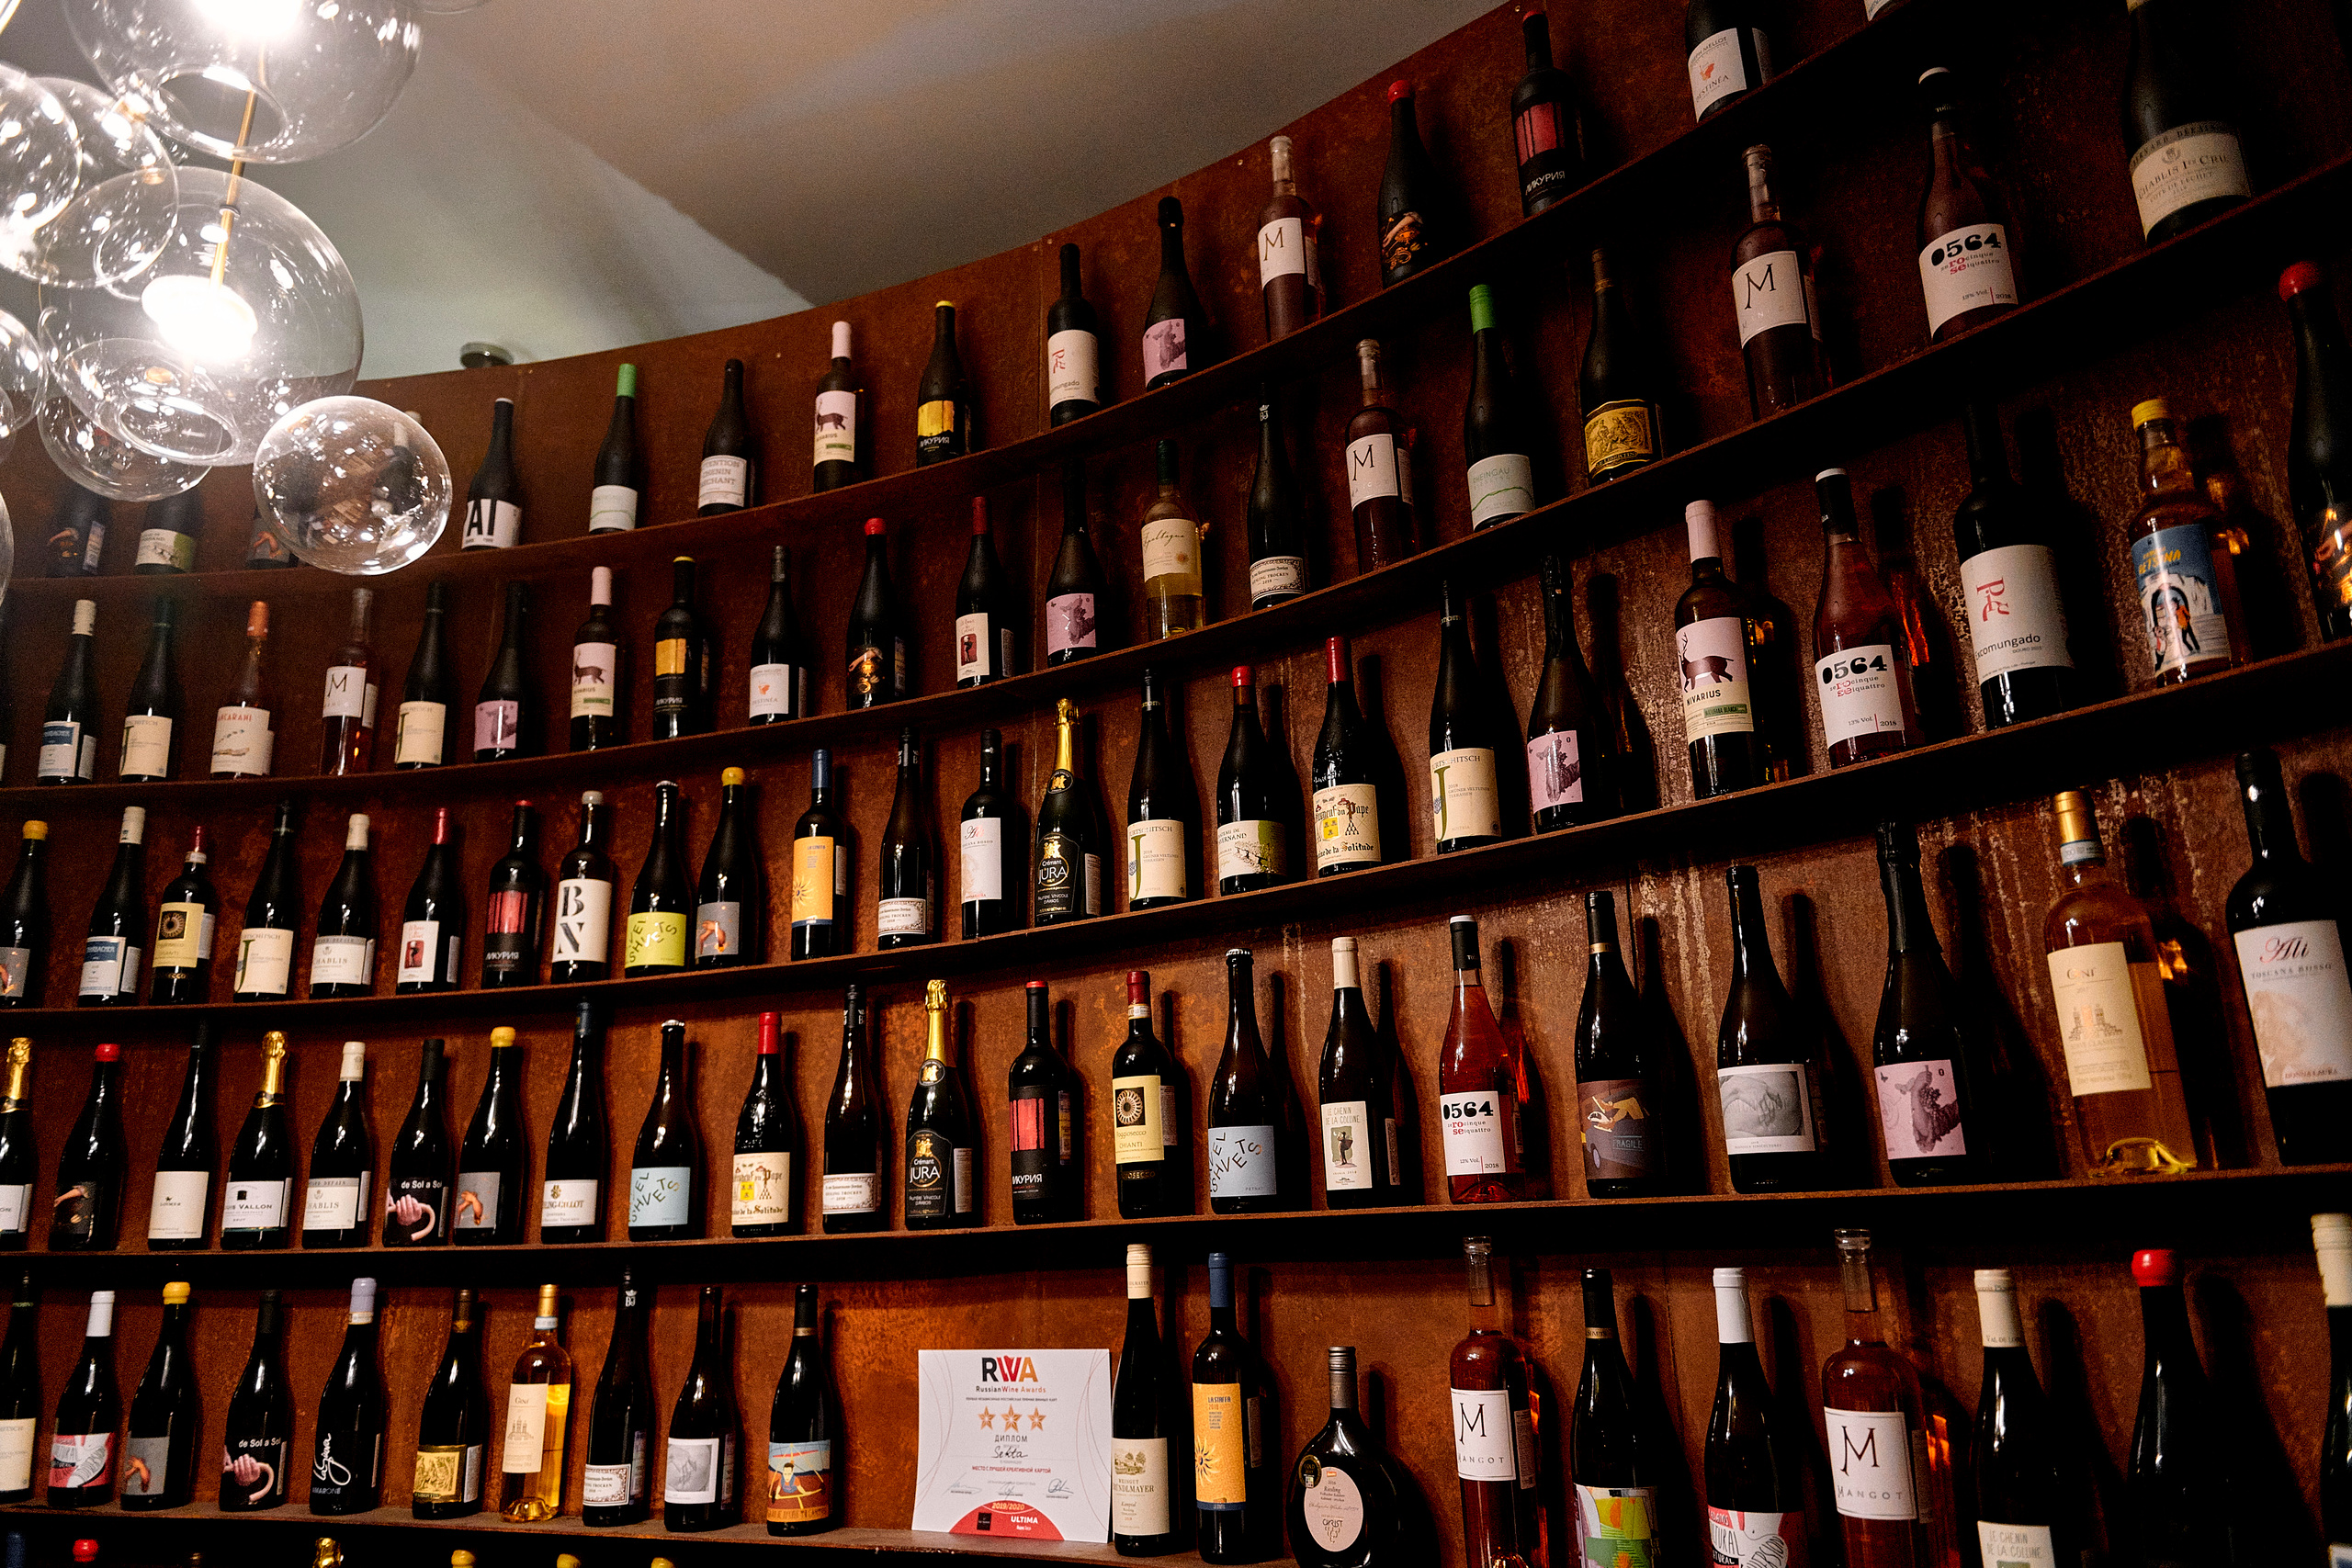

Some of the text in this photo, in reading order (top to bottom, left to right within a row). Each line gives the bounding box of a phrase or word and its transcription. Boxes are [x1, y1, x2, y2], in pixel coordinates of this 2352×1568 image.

[1263, 226, 1284, 262] M
[1931, 232, 2002, 266] 0564
[1744, 263, 1777, 310] M
[1352, 444, 1374, 481] M
[1822, 654, 1887, 684] 0564
[326, 673, 347, 697] M
[1686, 689, 1721, 706] NIVARIUS
[1346, 800, 1369, 818] Pape
[1340, 840, 1374, 852] Solitude
[1042, 859, 1062, 867] Crémant
[1038, 866, 1068, 885] JURA
[562, 886, 585, 917] B
[557, 922, 585, 955] N
[2259, 936, 2309, 964] Ali
[315, 956, 347, 965] HABLIS
[2251, 967, 2293, 979] TOSCANA
[1334, 1107, 1351, 1115] CHENIN
[1340, 1114, 1361, 1124] COLLINE
[1442, 1100, 1494, 1121] 0564
[1612, 1139, 1643, 1149] FRAGILE
[910, 1166, 941, 1183] JURA
[401, 1180, 410, 1190] de
[412, 1180, 424, 1189] Sol
[432, 1180, 442, 1189] Sol
[981, 1356, 1038, 1382] RWA
[1021, 1385, 1046, 1393] Awards
[1459, 1403, 1487, 1446] M
[239, 1440, 248, 1449] de
[250, 1438, 262, 1448] Sol
[270, 1437, 281, 1447] Sol
[994, 1435, 1028, 1444] ДИПЛОМ
[1840, 1426, 1880, 1477] M
[1838, 1484, 1904, 1501] MANGOT
[991, 1502, 1024, 1511] 2019/2020
[1011, 1516, 1038, 1524] ULTIMA
[1322, 1518, 1343, 1528] CHRIST
[2000, 1531, 2029, 1544] CHENIN
[2010, 1547, 2042, 1559] COLLINE
